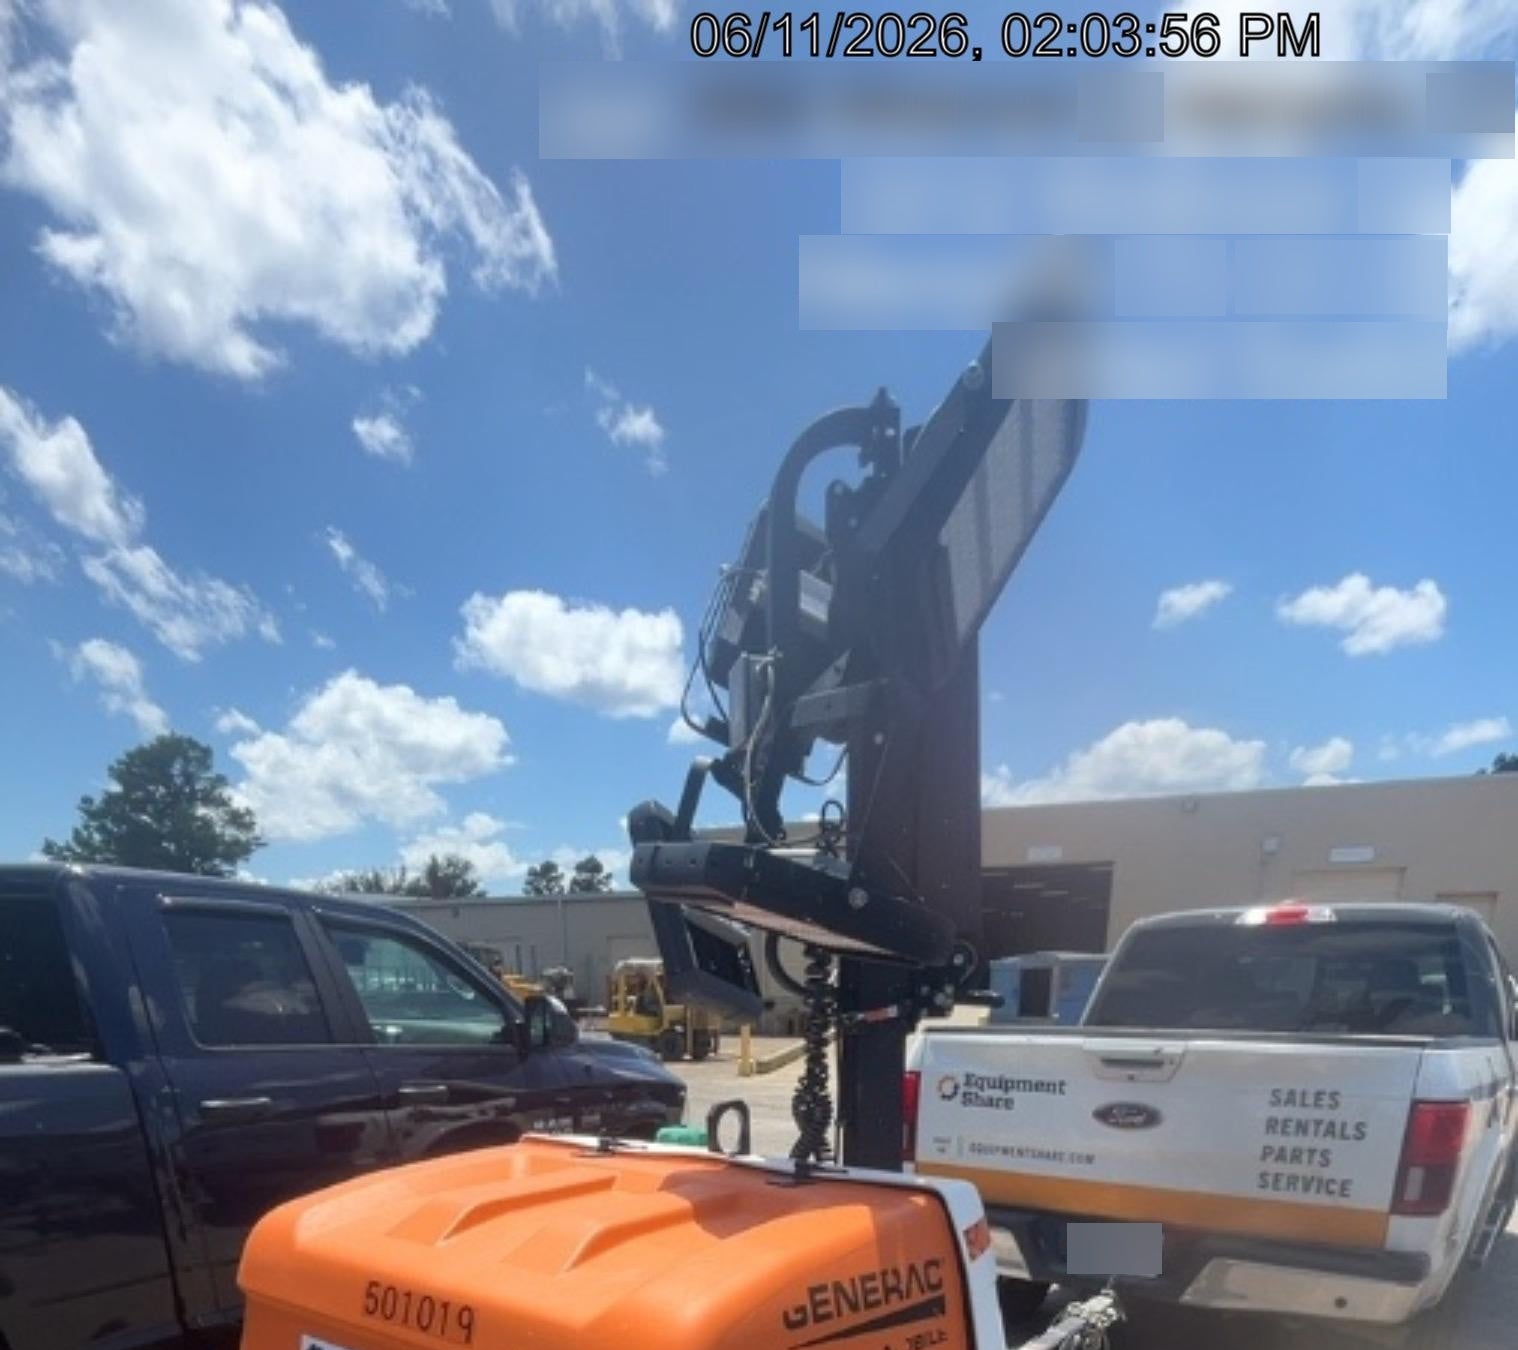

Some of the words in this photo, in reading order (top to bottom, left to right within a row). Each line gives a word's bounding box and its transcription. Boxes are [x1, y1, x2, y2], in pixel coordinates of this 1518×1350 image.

[963, 1072, 1067, 1096] Equipment
[961, 1091, 1016, 1111] Share
[1268, 1088, 1341, 1110] SALES
[1265, 1116, 1368, 1141] RENTALS
[1261, 1145, 1332, 1168] PARTS
[1258, 1171, 1353, 1198] SERVICE
[782, 1260, 944, 1330] GENERAC
[364, 1280, 475, 1344] 501019
